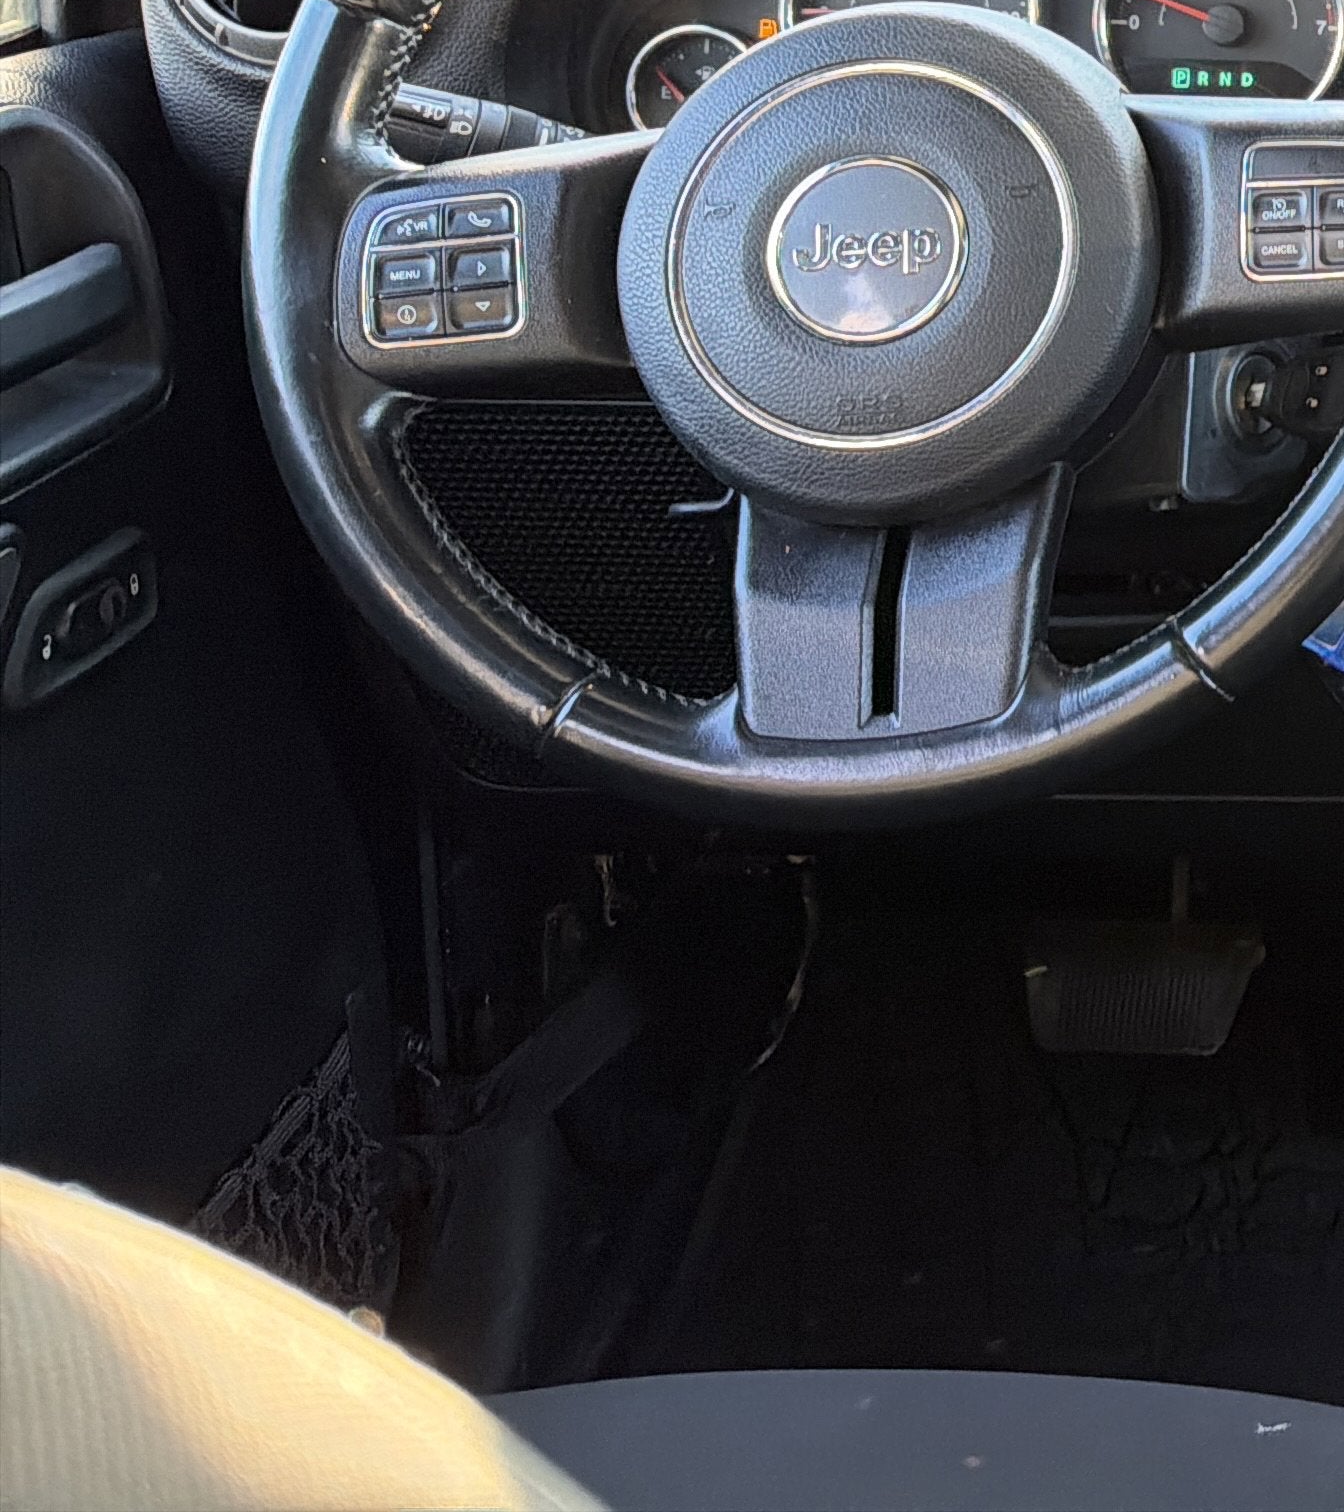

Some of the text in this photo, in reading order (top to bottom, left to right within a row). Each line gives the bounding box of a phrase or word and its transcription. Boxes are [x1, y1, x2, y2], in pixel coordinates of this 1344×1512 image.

[1129, 15, 1140, 30] 0
[1316, 20, 1326, 35] 7
[1197, 73, 1209, 86] R
[1219, 73, 1232, 86] N
[1241, 73, 1254, 86] D
[662, 86, 671, 100] E
[792, 223, 940, 274] Jeep
[1261, 245, 1298, 255] CANCEL
[390, 269, 421, 281] MENU
